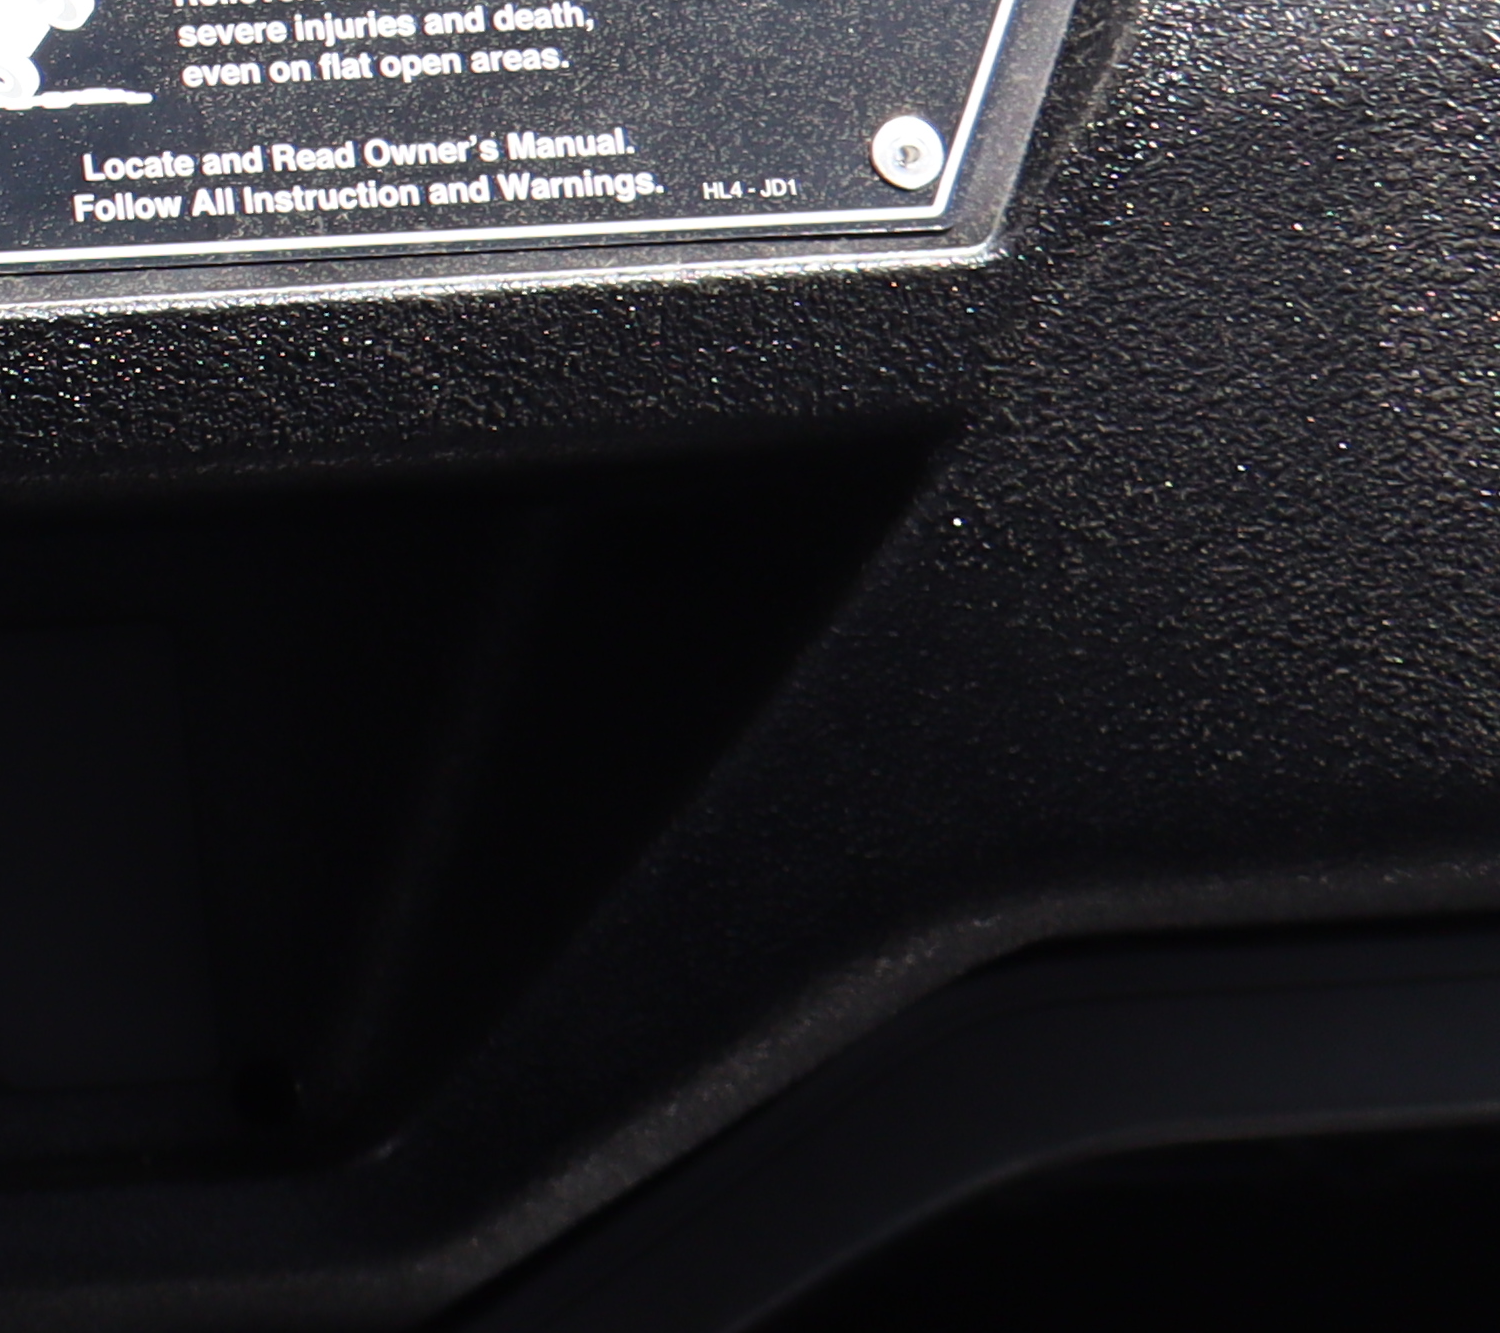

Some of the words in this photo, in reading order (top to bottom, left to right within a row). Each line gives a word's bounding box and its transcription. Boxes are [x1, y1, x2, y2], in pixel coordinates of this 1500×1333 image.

[179, 21, 287, 47] severe
[294, 10, 416, 47] injuries
[424, 5, 485, 35] and
[493, 1, 594, 31] death,
[183, 62, 261, 87] even
[269, 60, 312, 83] on
[319, 52, 373, 80] flat
[380, 53, 462, 83] open
[471, 48, 569, 73] areas.
[83, 151, 194, 181] Locate
[202, 145, 263, 175] and
[272, 141, 355, 171] Read
[364, 135, 499, 167] Owner's
[507, 127, 635, 160] Manual.
[74, 192, 182, 222] Follow
[192, 187, 235, 216] All
[243, 180, 420, 214] Instruction
[429, 175, 490, 205] and
[497, 169, 664, 202] Warnings.
